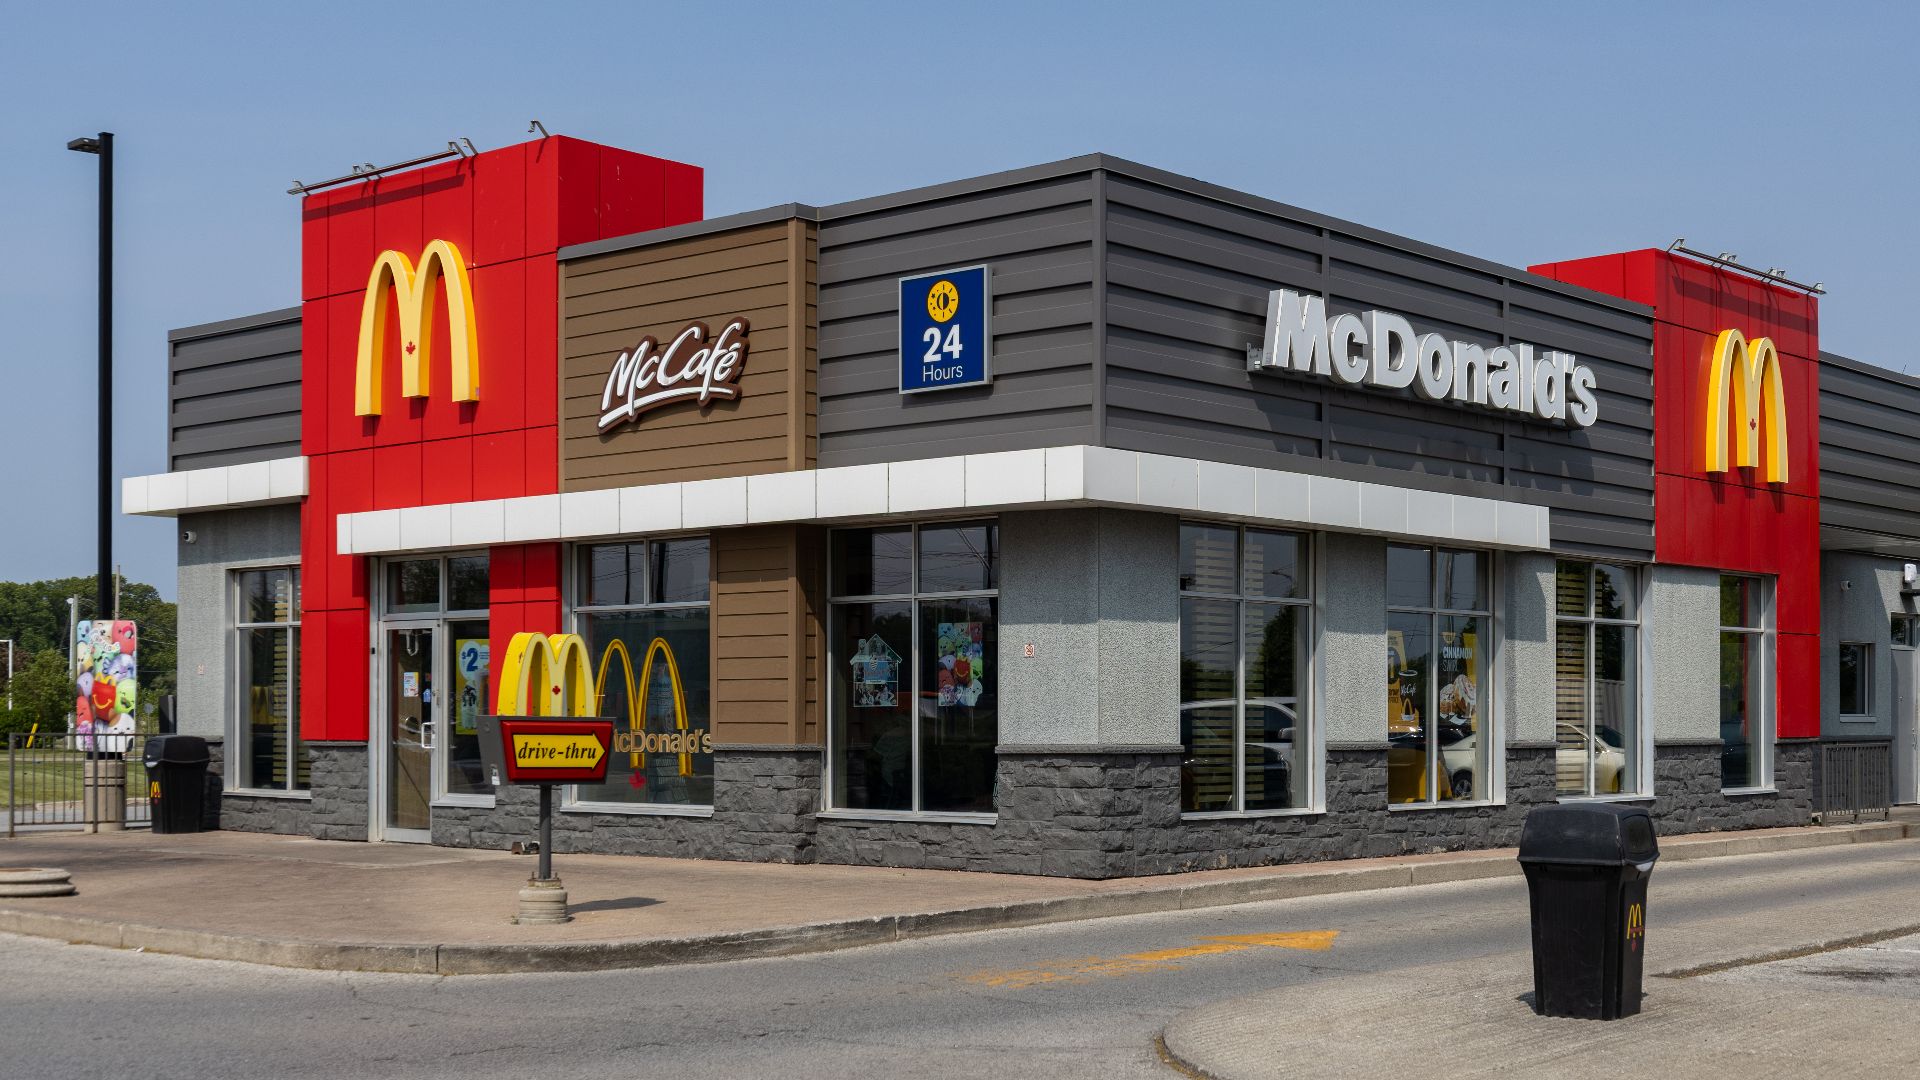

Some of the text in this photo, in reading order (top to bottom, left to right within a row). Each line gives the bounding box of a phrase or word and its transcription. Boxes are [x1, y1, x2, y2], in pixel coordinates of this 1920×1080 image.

[923, 324, 963, 363] 24
[1262, 289, 1598, 428] McDonald's
[600, 322, 742, 420] McCafé
[923, 365, 963, 382] Hours
[461, 648, 479, 672] $2
[1442, 646, 1473, 660] CINNAMON
[518, 741, 597, 760] drive-thru
